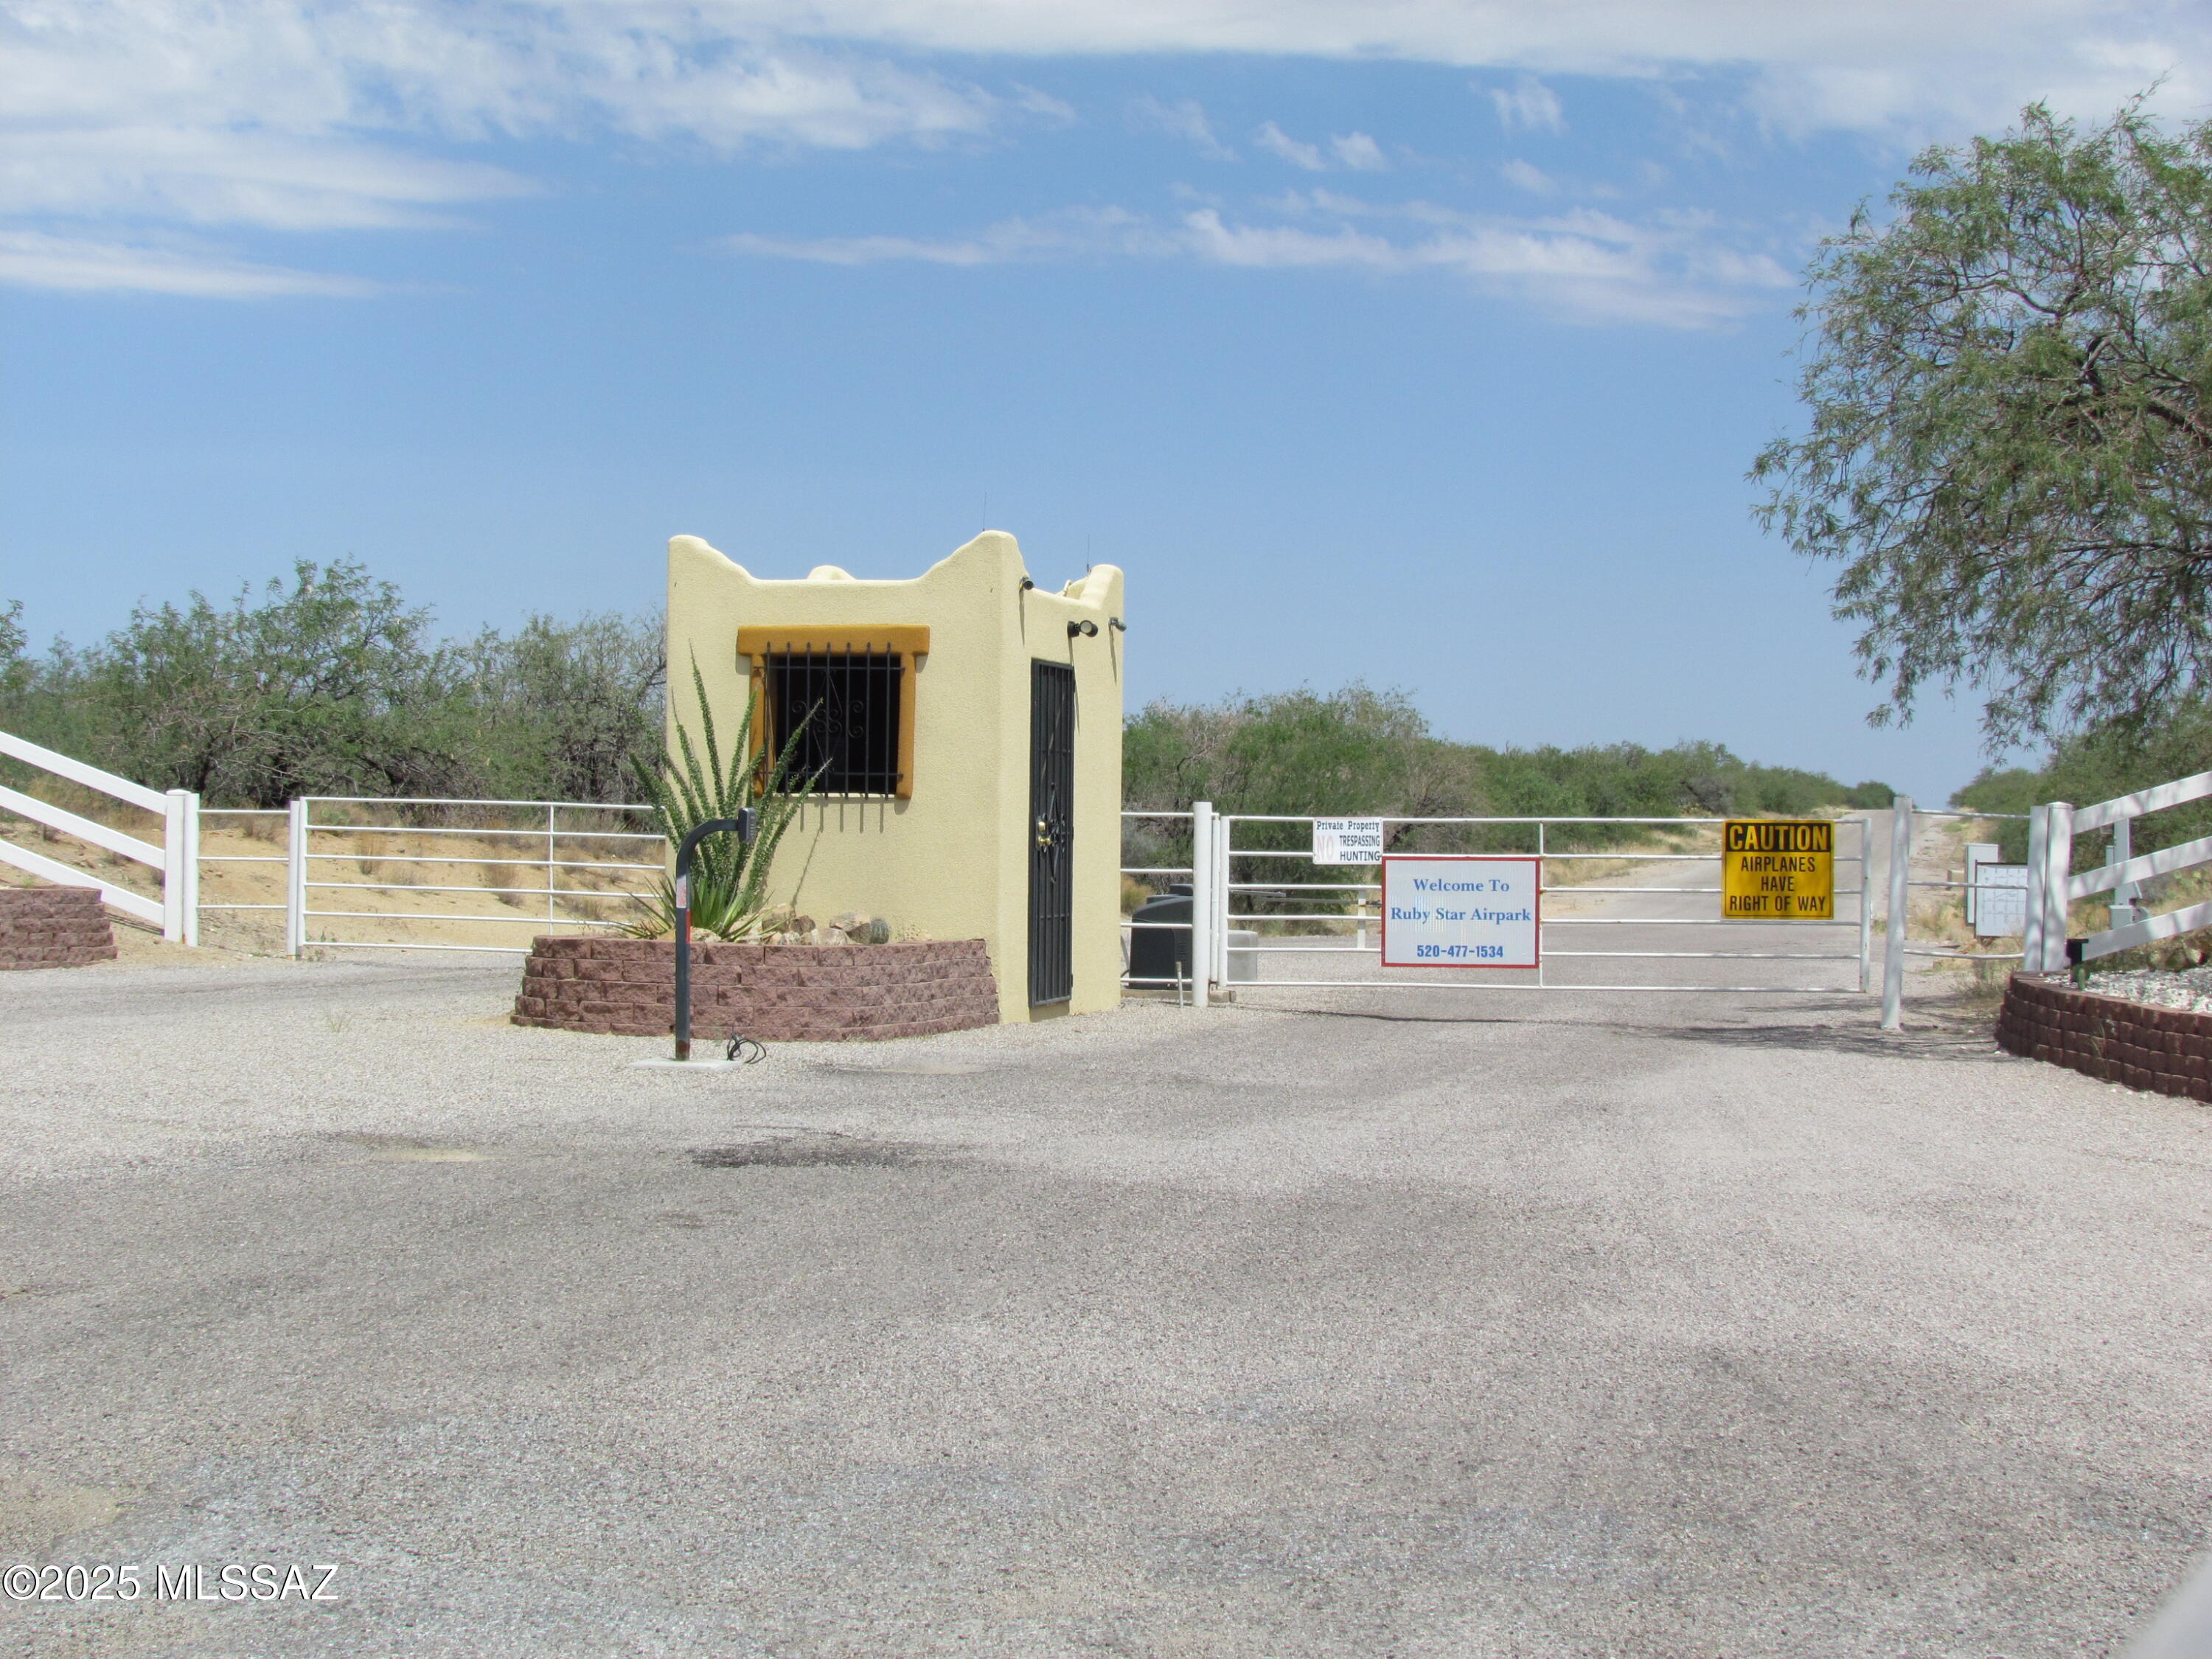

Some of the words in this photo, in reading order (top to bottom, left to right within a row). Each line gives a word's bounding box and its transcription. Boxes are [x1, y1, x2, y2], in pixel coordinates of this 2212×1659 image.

[1316, 821, 1343, 830] Private
[1348, 821, 1380, 832] Property
[1339, 835, 1380, 846] TRESPASSING
[1729, 825, 1827, 850] CAUTION
[1316, 836, 1334, 860] NO
[1339, 851, 1380, 861] HUNTING
[1740, 857, 1815, 872] AIRPLANES
[1413, 878, 1484, 891] Welcome
[1489, 880, 1510, 892] To
[1761, 876, 1795, 892] HAVE
[1730, 896, 1769, 911] RIGHT
[1775, 896, 1791, 911] OF
[1798, 896, 1826, 911] WAY
[1391, 908, 1430, 923] Ruby
[1435, 908, 1466, 921] Star
[1471, 908, 1531, 925] Airpark
[1416, 945, 1504, 958] 520-477-1534
